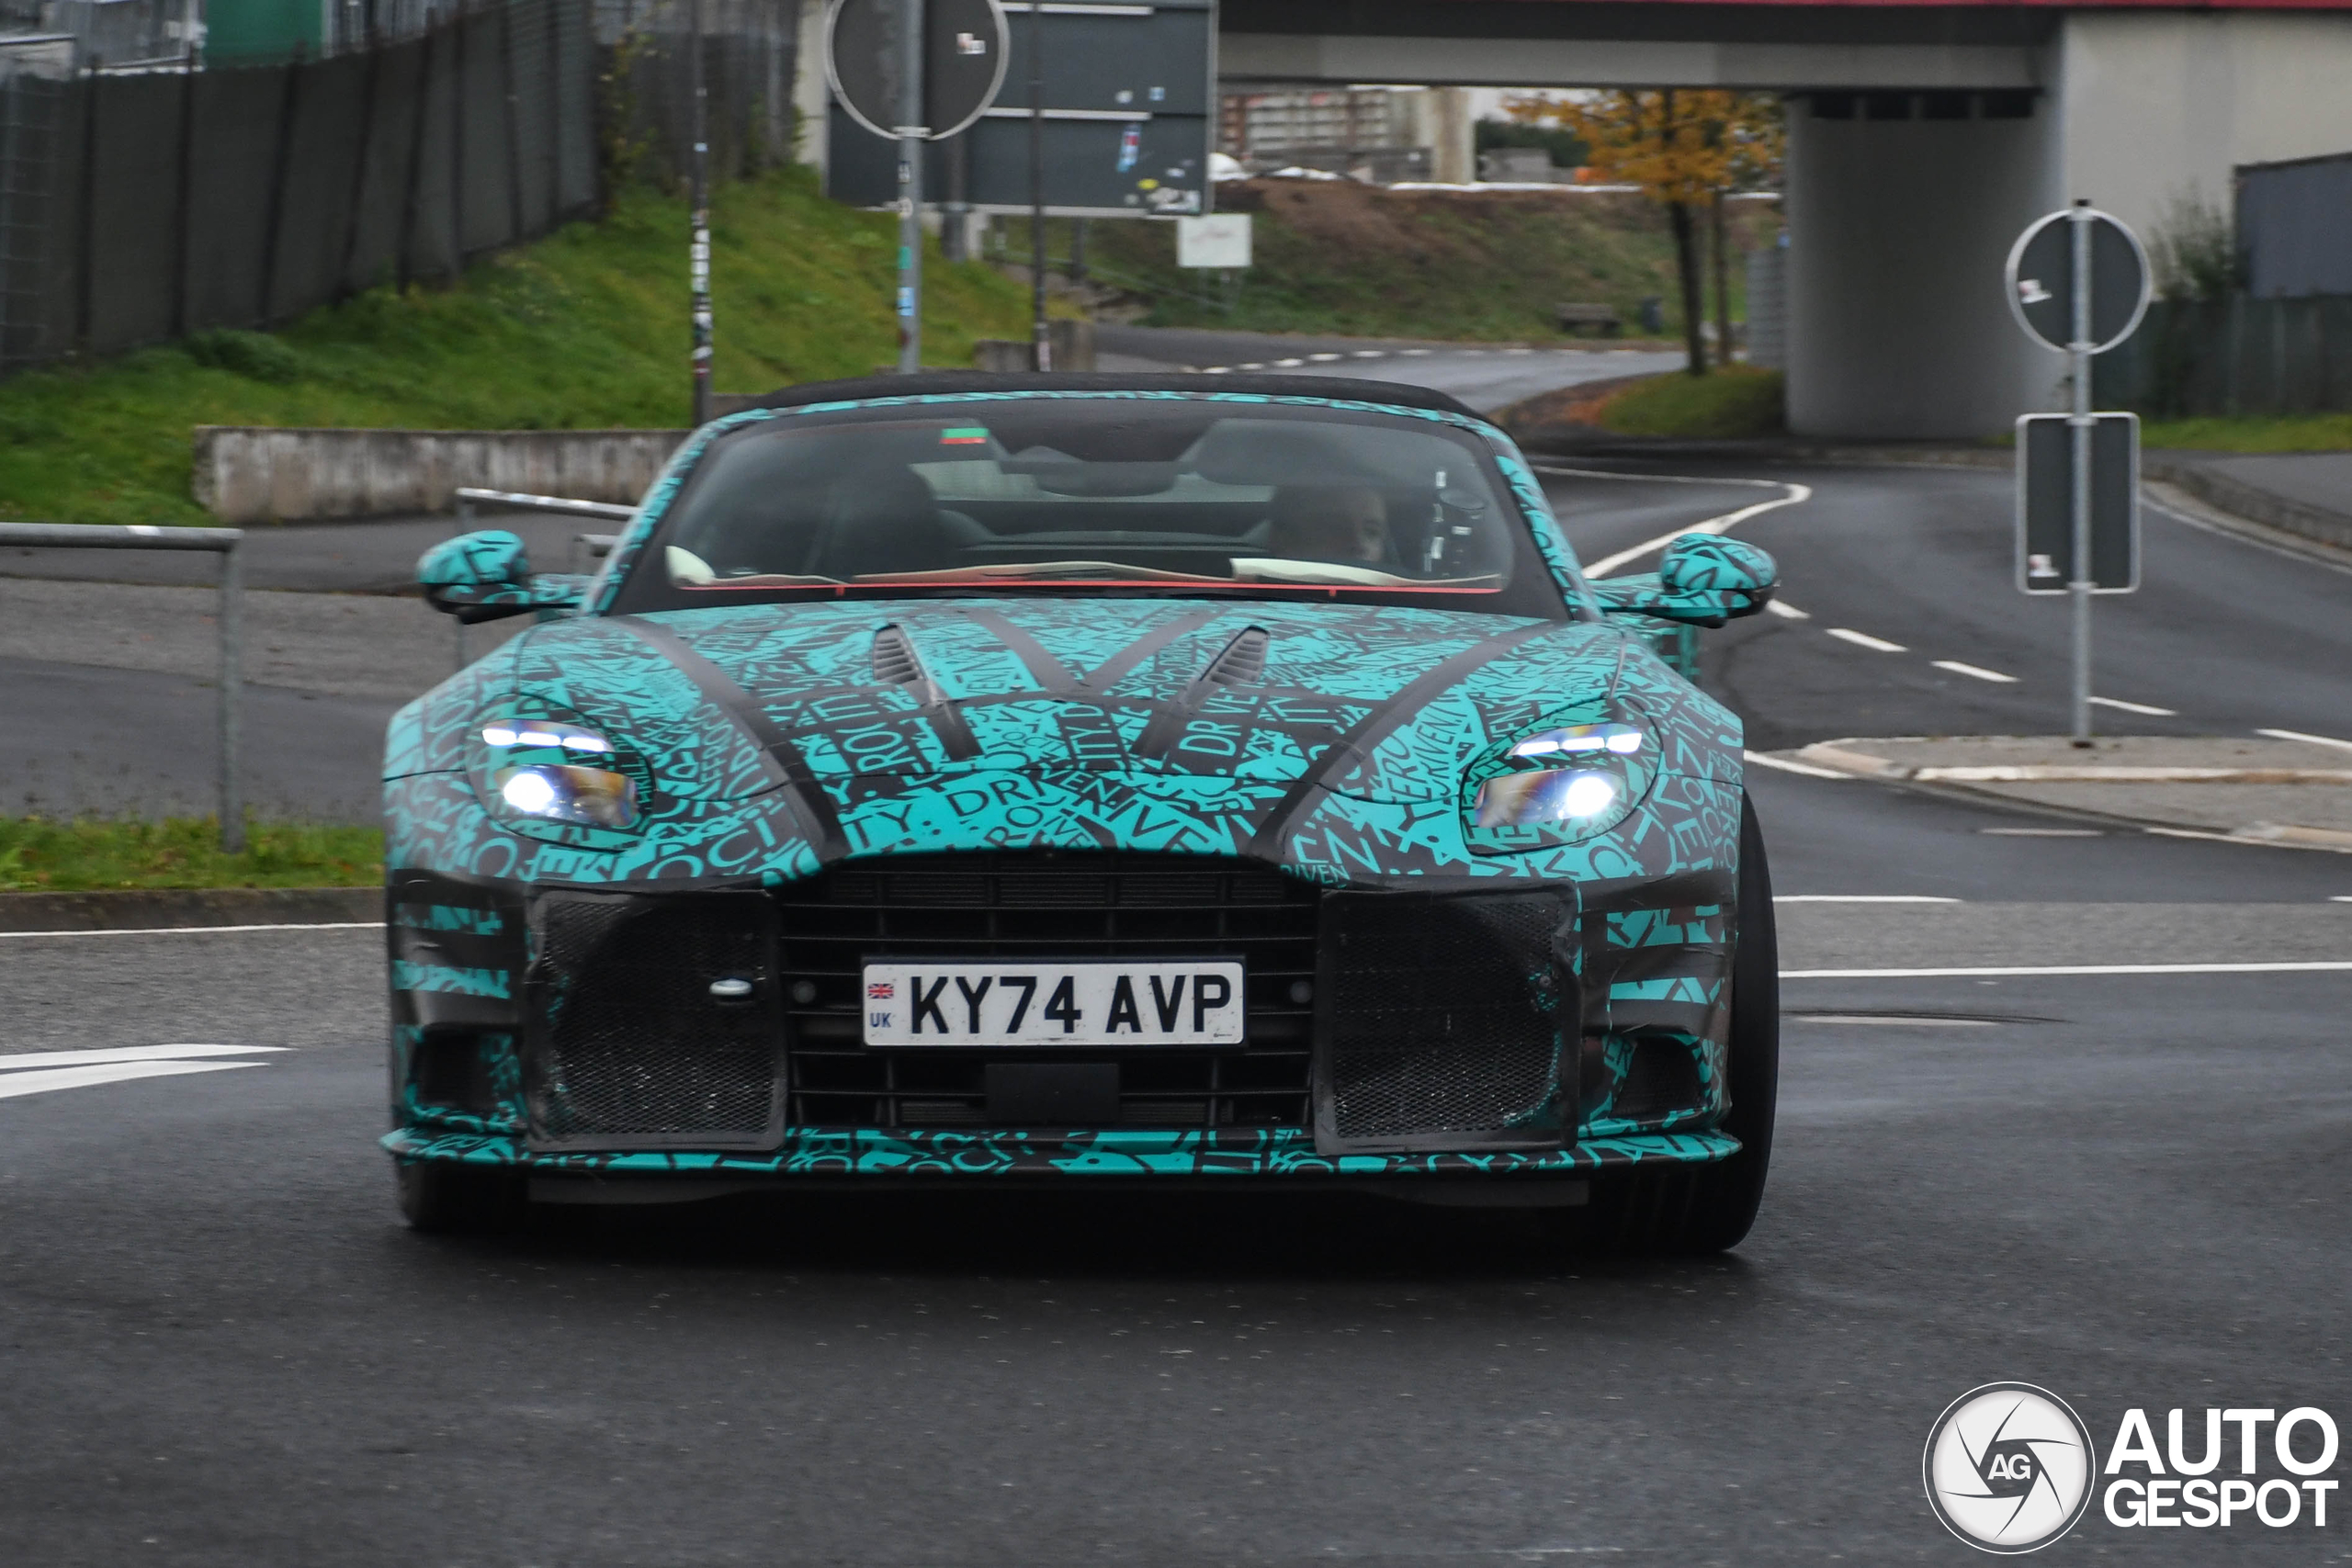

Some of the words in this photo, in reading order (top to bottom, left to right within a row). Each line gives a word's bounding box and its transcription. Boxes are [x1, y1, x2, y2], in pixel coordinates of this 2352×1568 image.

[870, 1012, 892, 1028] UK
[910, 976, 1082, 1034] KY74
[1105, 974, 1231, 1033] AVP
